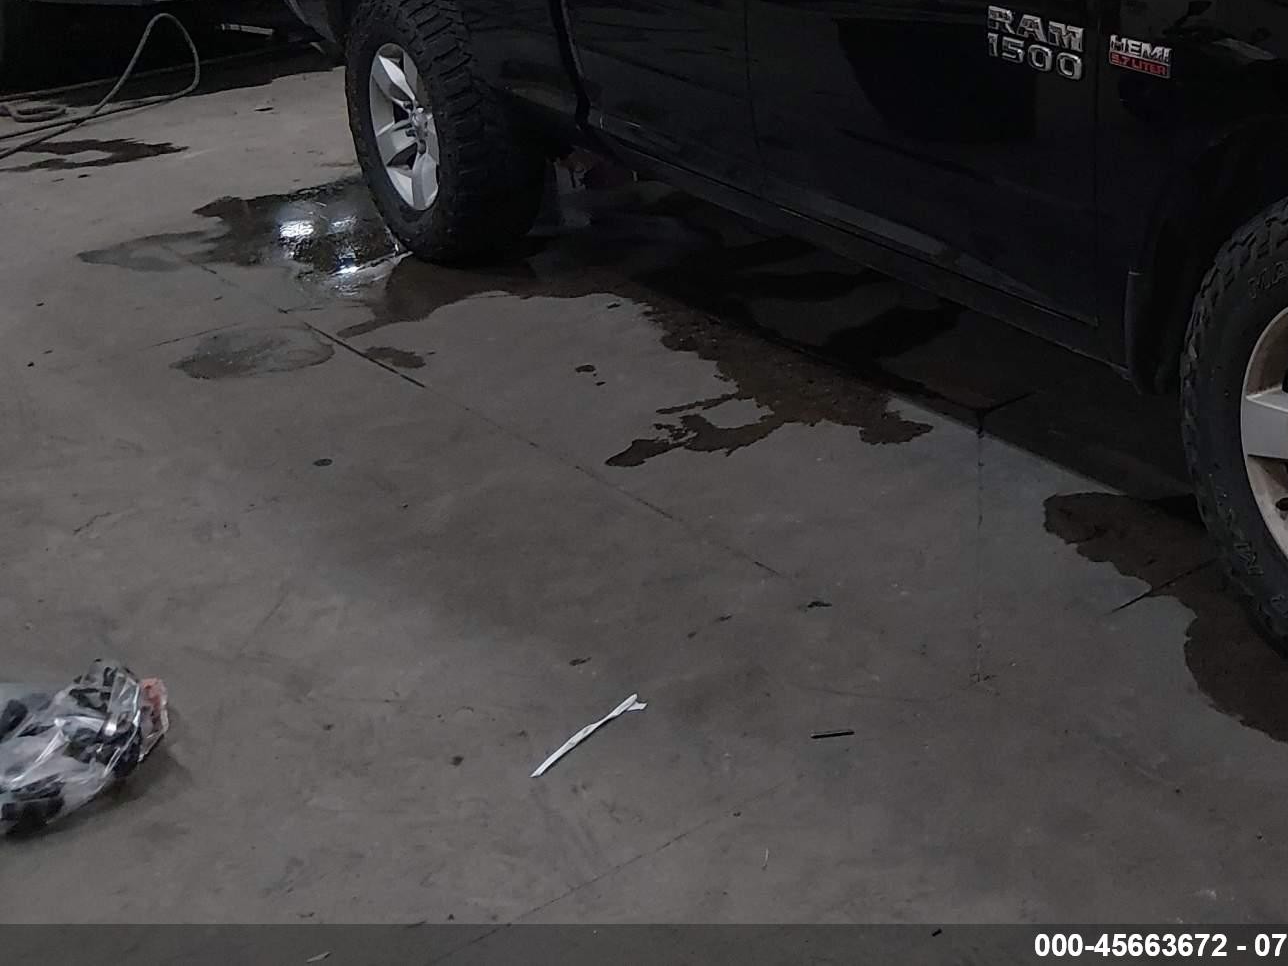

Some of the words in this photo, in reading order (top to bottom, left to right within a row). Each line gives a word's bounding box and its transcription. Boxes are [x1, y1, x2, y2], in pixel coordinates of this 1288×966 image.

[987, 4, 1084, 52] RAM
[987, 32, 1084, 81] 1500
[1109, 34, 1172, 63] HEMI
[1111, 51, 1130, 67] 5.7
[1132, 55, 1168, 76] LITER
